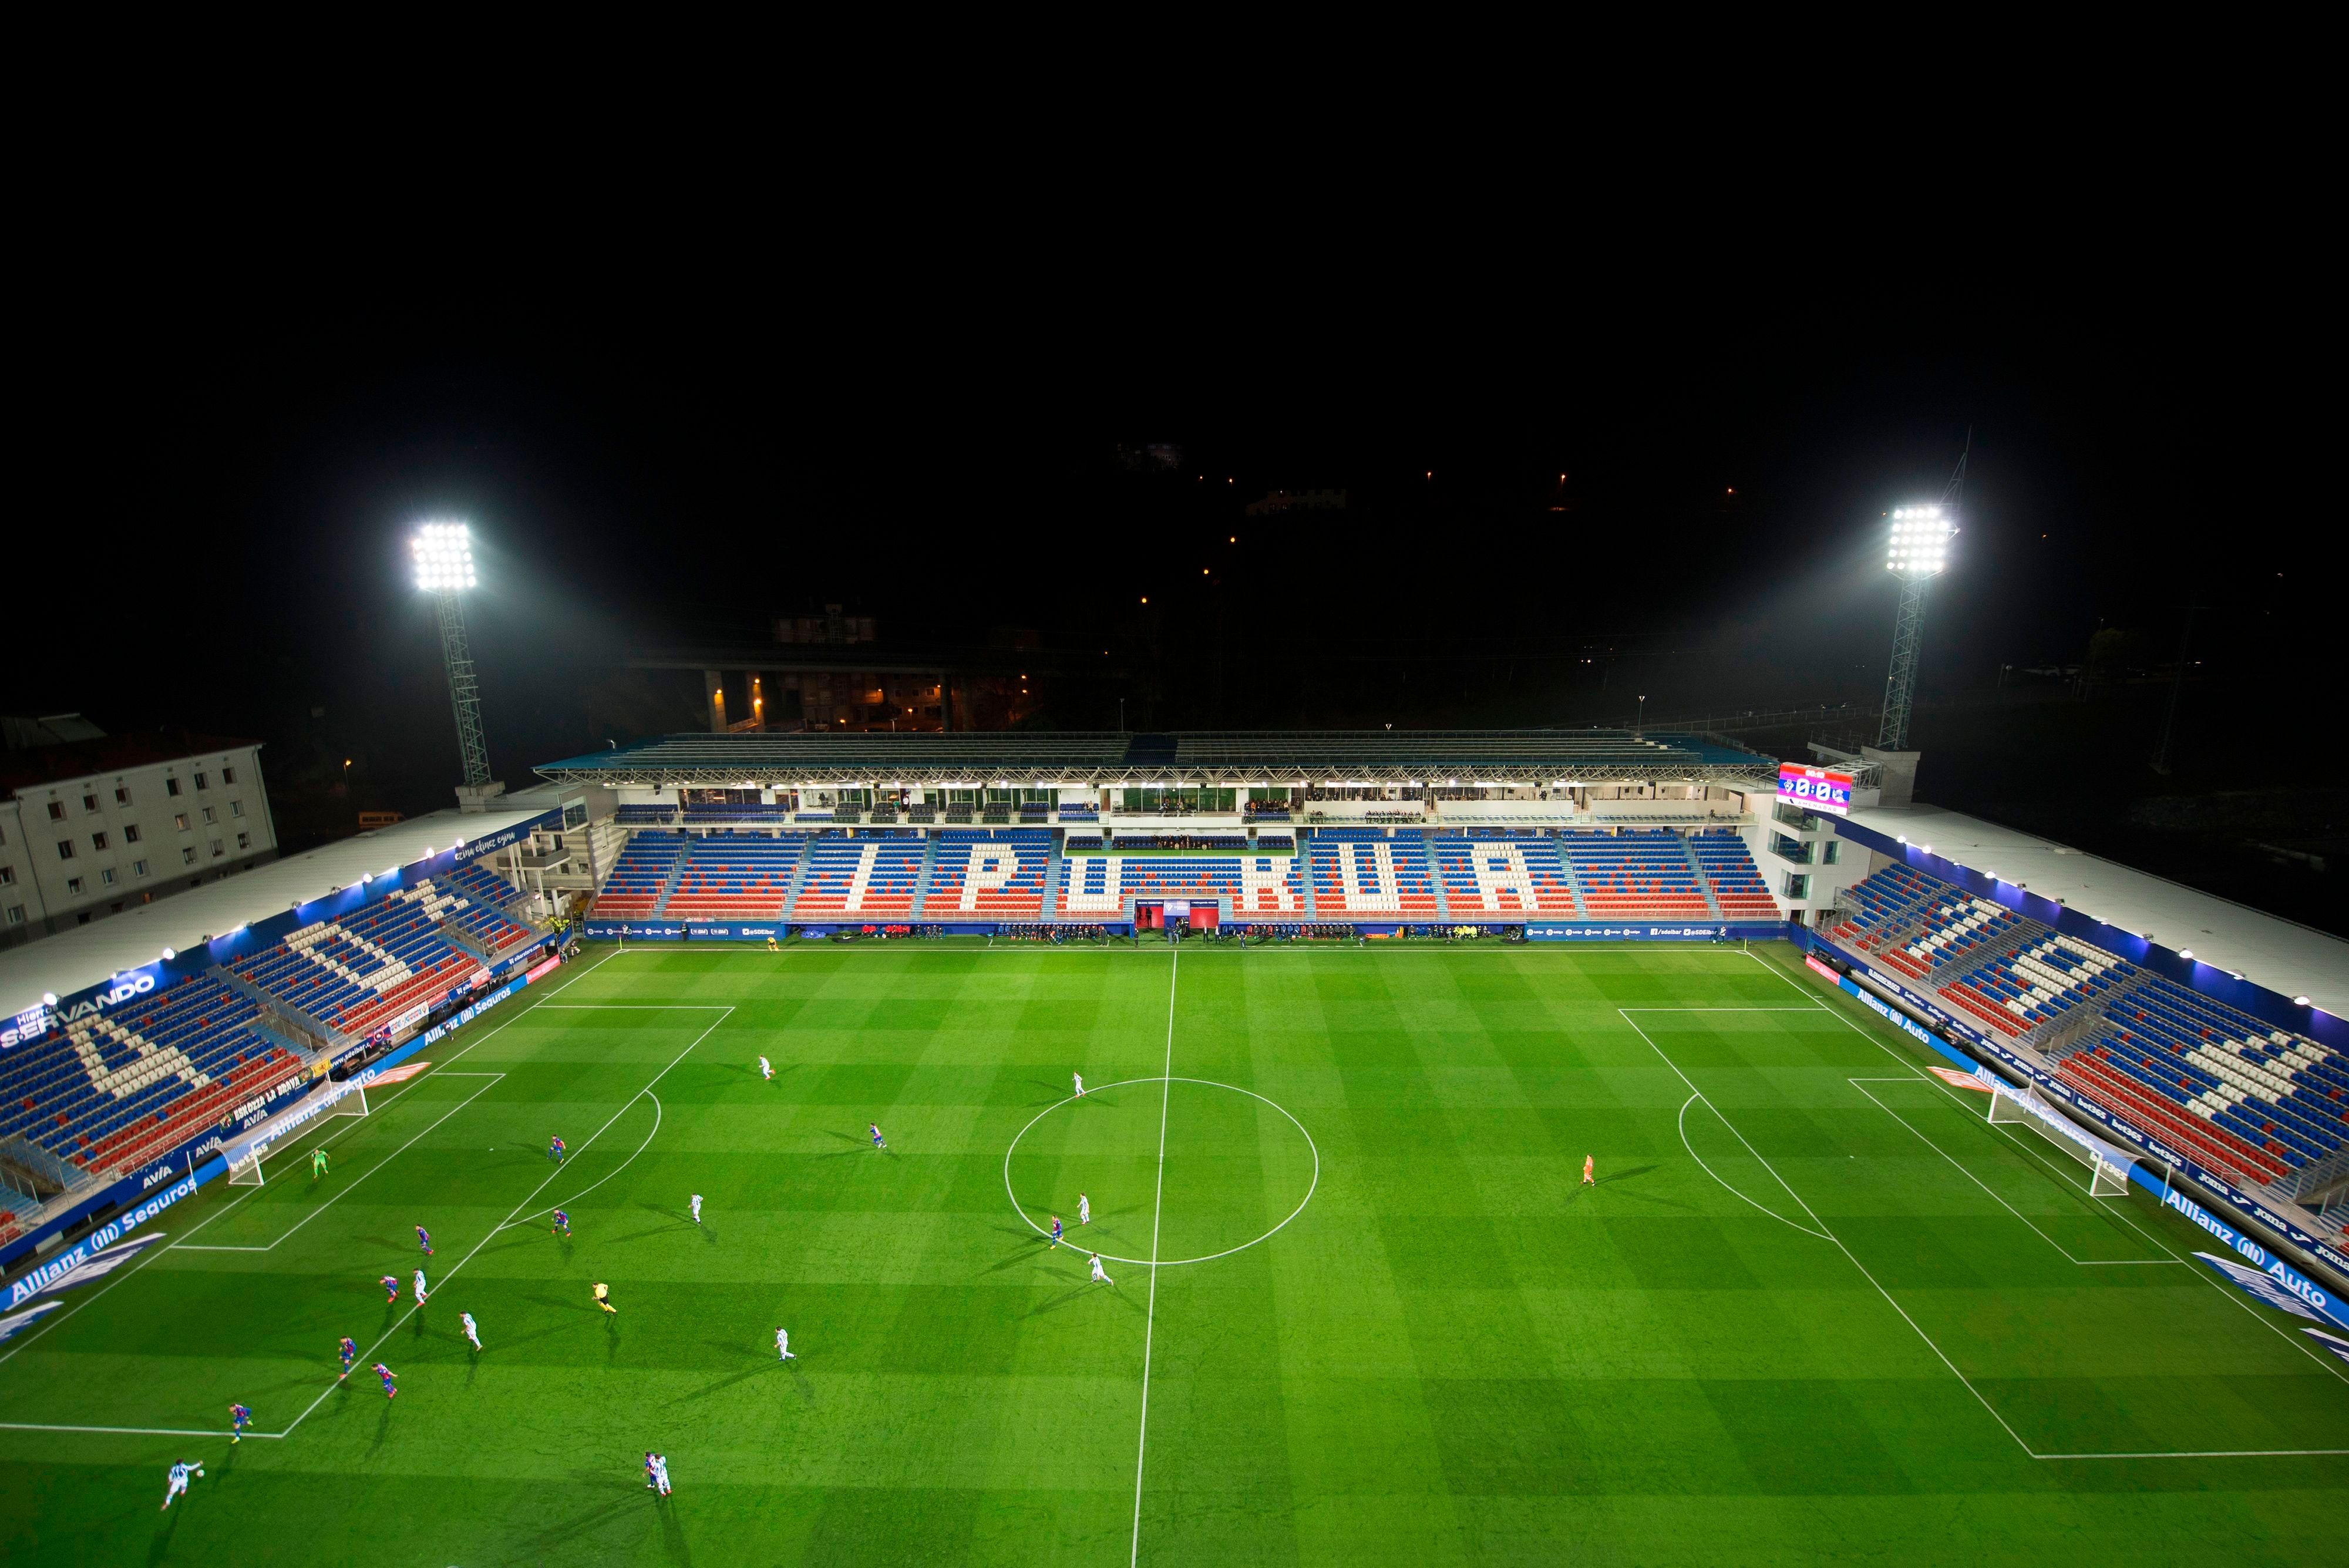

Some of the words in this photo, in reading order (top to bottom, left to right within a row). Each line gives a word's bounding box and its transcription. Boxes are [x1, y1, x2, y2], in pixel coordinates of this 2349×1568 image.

[1798, 801, 1837, 812] AMENABAR
[514, 944, 540, 961] eibarstore.com
[0, 975, 155, 1048] SERVANDO
[475, 987, 511, 1014] Seguros
[16, 1005, 58, 1025] Hierros
[1857, 988, 1889, 1017] Allianz
[1903, 1019, 1929, 1044] Auto
[234, 1096, 265, 1122] ESKOZZA
[265, 1089, 277, 1103] LA
[277, 1076, 300, 1096] BRAVA
[2078, 1098, 2106, 1119] bet365
[2112, 1119, 2142, 1142] bet365
[2148, 1141, 2182, 1166] bet365
[12, 1246, 88, 1303] Allianz
[122, 1179, 197, 1231] Seguros
[2166, 1190, 2233, 1245] Allianz
[2268, 1262, 2326, 1307] Auto
